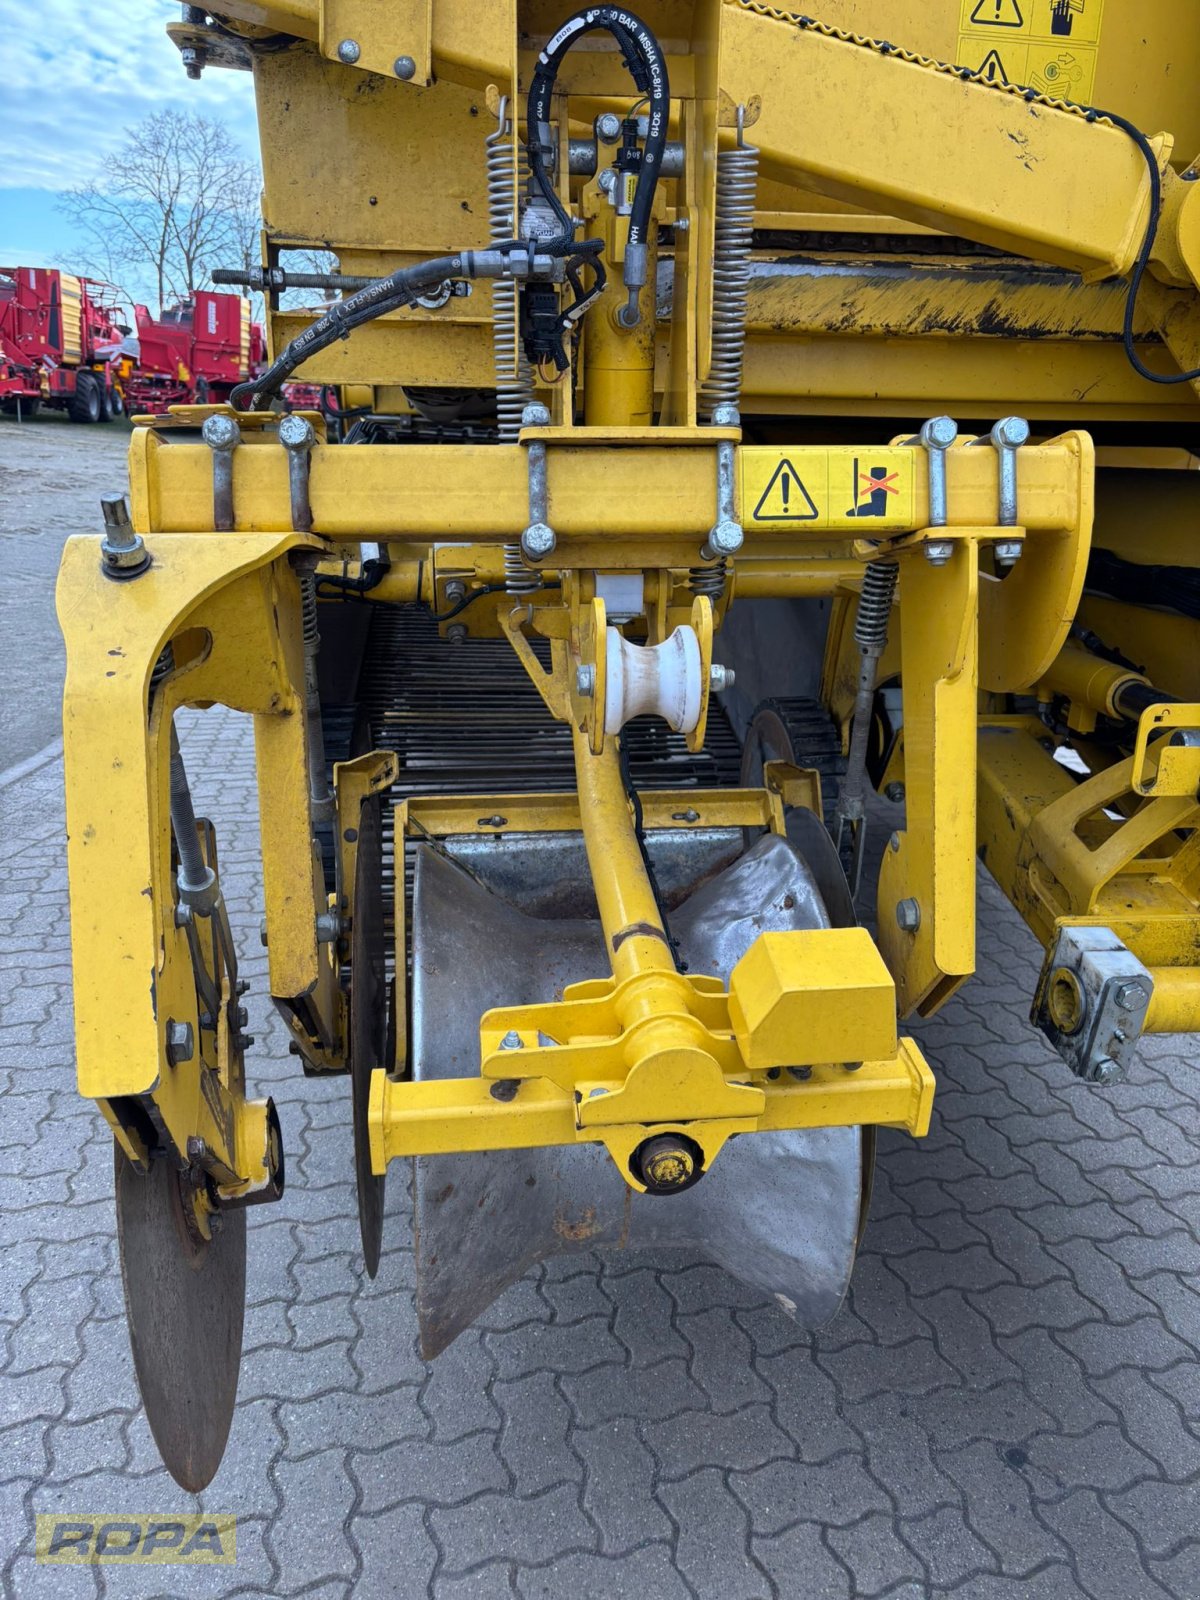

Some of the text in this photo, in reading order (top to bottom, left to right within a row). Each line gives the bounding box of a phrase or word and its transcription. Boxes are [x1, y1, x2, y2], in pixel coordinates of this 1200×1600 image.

[618, 13, 638, 32] BAR
[638, 32, 656, 64] MSHA
[650, 111, 661, 138] 3Q19
[304, 329, 316, 342] EN
